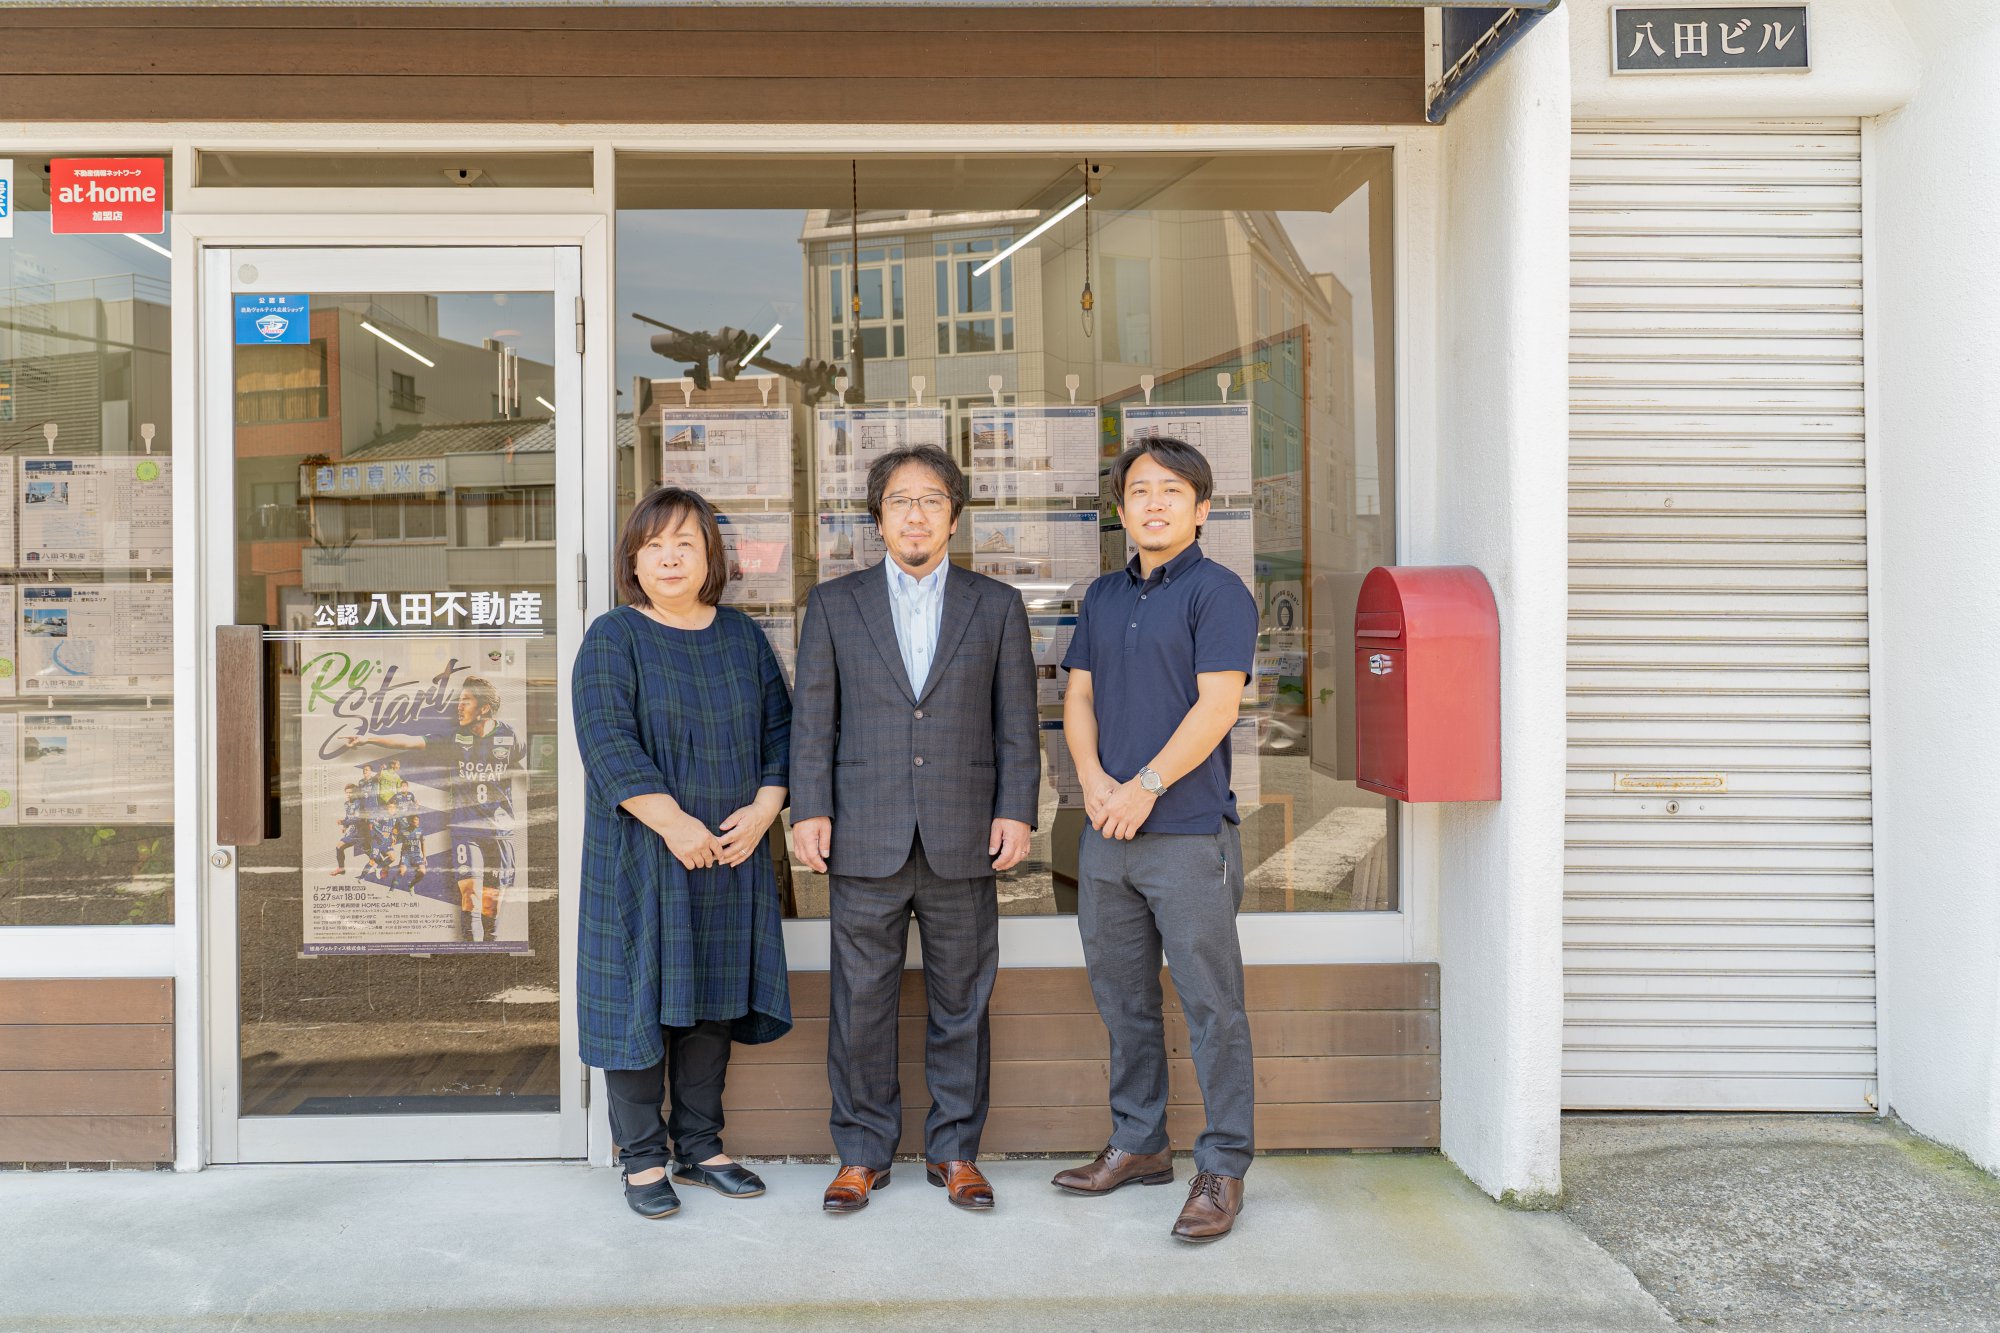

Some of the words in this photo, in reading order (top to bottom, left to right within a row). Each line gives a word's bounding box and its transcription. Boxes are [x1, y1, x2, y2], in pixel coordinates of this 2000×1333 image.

[1628, 18, 1796, 58] 八田ビル
[73, 169, 142, 177] 不動産情報ネットワーク
[92, 211, 123, 221] 加盟店
[41, 462, 57, 470] 土地
[41, 552, 86, 560] 八田不動産
[41, 589, 57, 597] 土地
[313, 604, 359, 626] 公認
[363, 590, 543, 626] 八田不動産
[41, 679, 85, 687] 八田不動産
[318, 658, 471, 760] Start
[458, 760, 508, 773] POCARI
[459, 769, 503, 782] SWEAT
[476, 784, 488, 804] 8
[40, 807, 83, 815] 八田不動産
[456, 844, 468, 864] 8
[345, 893, 366, 901] 18:00
